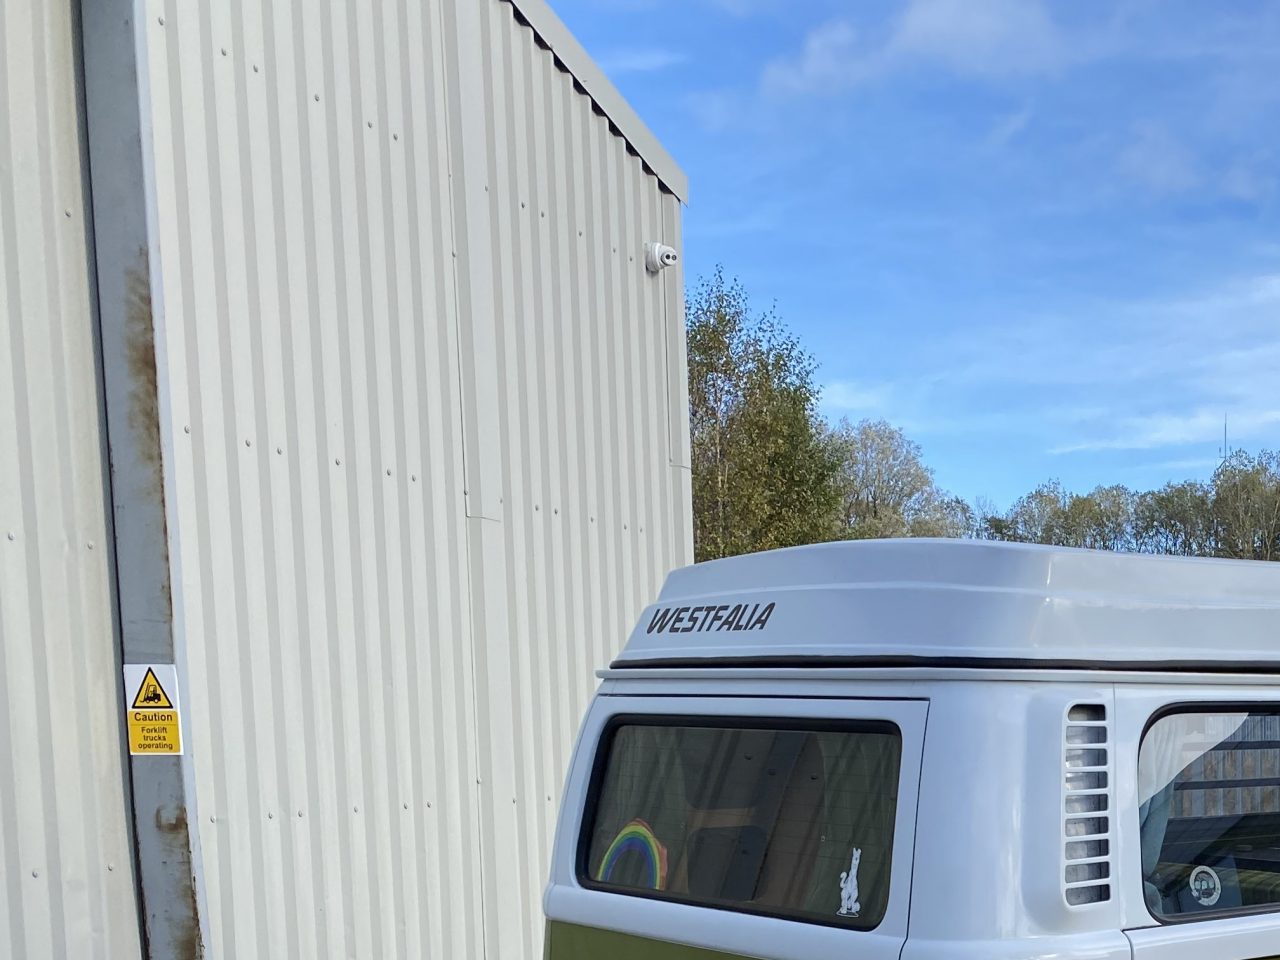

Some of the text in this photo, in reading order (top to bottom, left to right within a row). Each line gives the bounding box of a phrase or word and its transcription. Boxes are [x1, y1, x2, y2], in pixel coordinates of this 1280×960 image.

[647, 602, 776, 634] WESTFALIA
[134, 712, 173, 722] Caution
[141, 726, 168, 734] Forklift
[138, 742, 173, 750] operating
